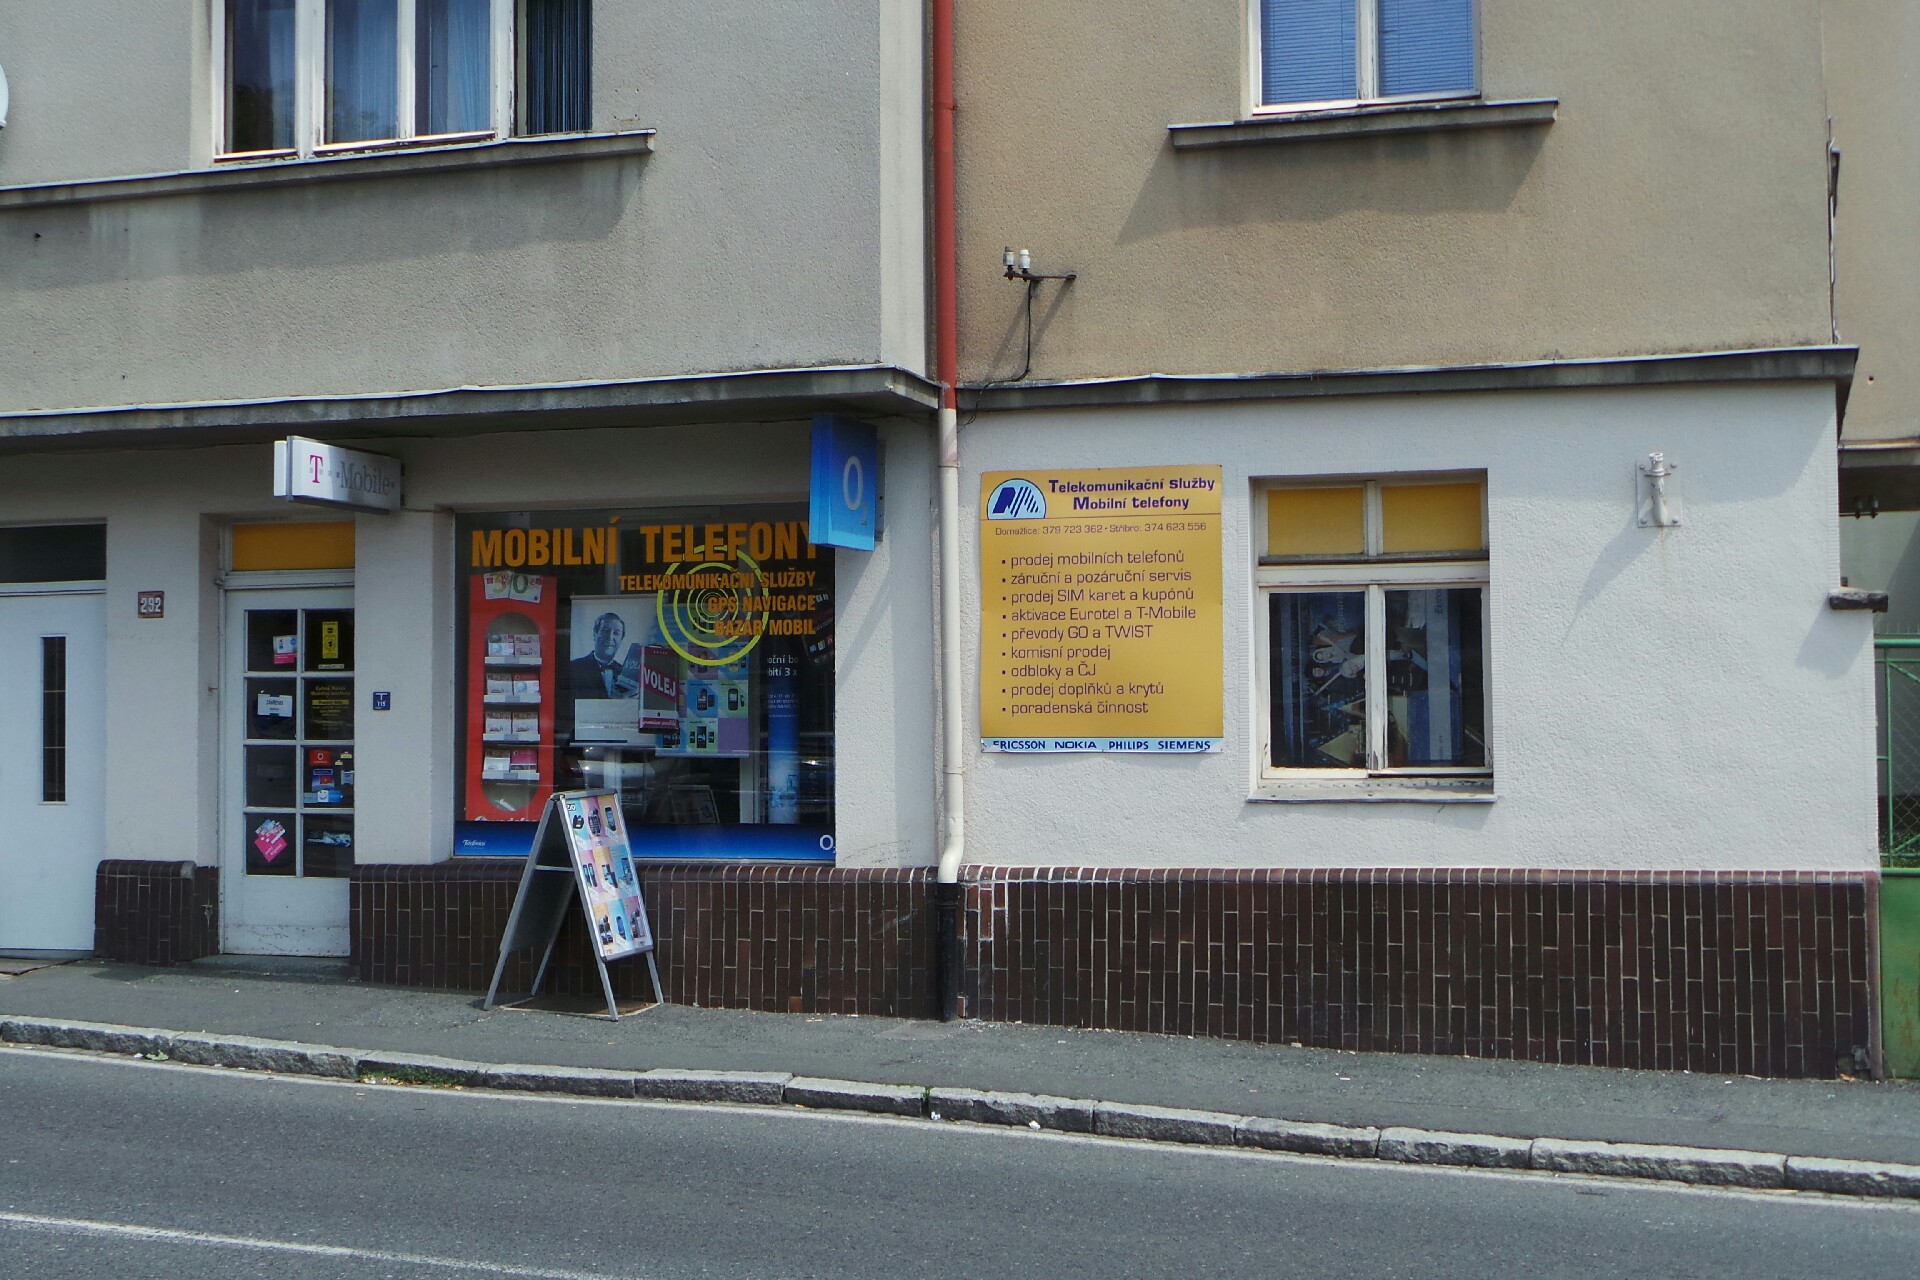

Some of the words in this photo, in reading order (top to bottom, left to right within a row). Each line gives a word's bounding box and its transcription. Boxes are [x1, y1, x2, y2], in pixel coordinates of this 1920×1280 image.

[1049, 479, 1164, 492] Telekomunikační
[1170, 478, 1214, 491] služby
[1074, 497, 1127, 510] Mobilní
[1132, 496, 1189, 510] telefony
[1042, 526, 1061, 534] 379
[1064, 525, 1082, 534] 723
[1084, 524, 1103, 534] 362
[1144, 522, 1164, 532] 374
[1166, 522, 1184, 532] 623
[1187, 522, 1207, 531] 556
[472, 516, 619, 567] MOBILNÍ
[1011, 553, 1054, 568] prodej
[1058, 552, 1123, 565] mobilních
[1127, 550, 1184, 564] telefonů
[619, 569, 755, 591] TELEKOMUNIKAČNÍ
[761, 567, 816, 588] SLUŽBY
[1011, 572, 1060, 584] záruční
[1064, 574, 1072, 583] a
[1077, 570, 1145, 584] pozáruční
[1149, 570, 1192, 582] servis
[141, 597, 161, 612] 292
[707, 597, 738, 612] GPS
[743, 595, 816, 611] NAVIGACE
[1011, 590, 1054, 605] prodej
[1058, 590, 1084, 602] SIM
[1089, 589, 1125, 602] karet
[1130, 592, 1137, 600] a
[1142, 588, 1194, 602] kupónů
[1011, 610, 1066, 622] aktivace
[1070, 608, 1119, 620] Eurotel
[1124, 610, 1132, 619] a
[1137, 606, 1196, 619] T-Mobile
[715, 620, 763, 636] BAZAR
[768, 619, 816, 635] MOBIL
[1011, 627, 1064, 642] převody
[1068, 626, 1088, 639] GO
[1092, 629, 1100, 638] a
[1105, 625, 1153, 638] TWIST
[1011, 646, 1063, 659] komisní
[1067, 646, 1111, 661] prodej
[1011, 664, 1062, 678] odbloky
[1066, 667, 1074, 676] a
[1078, 663, 1096, 677] ČJ
[644, 668, 676, 698] VOLEJ
[1011, 684, 1054, 698] prodej
[1058, 682, 1112, 696] doplňků
[1116, 685, 1124, 694] a
[1129, 682, 1164, 696] krytů
[1011, 701, 1092, 716] poradenská
[1097, 700, 1148, 714] činnost
[1109, 741, 1148, 750] PHILIPS
[1158, 740, 1210, 750] SIEMENS
